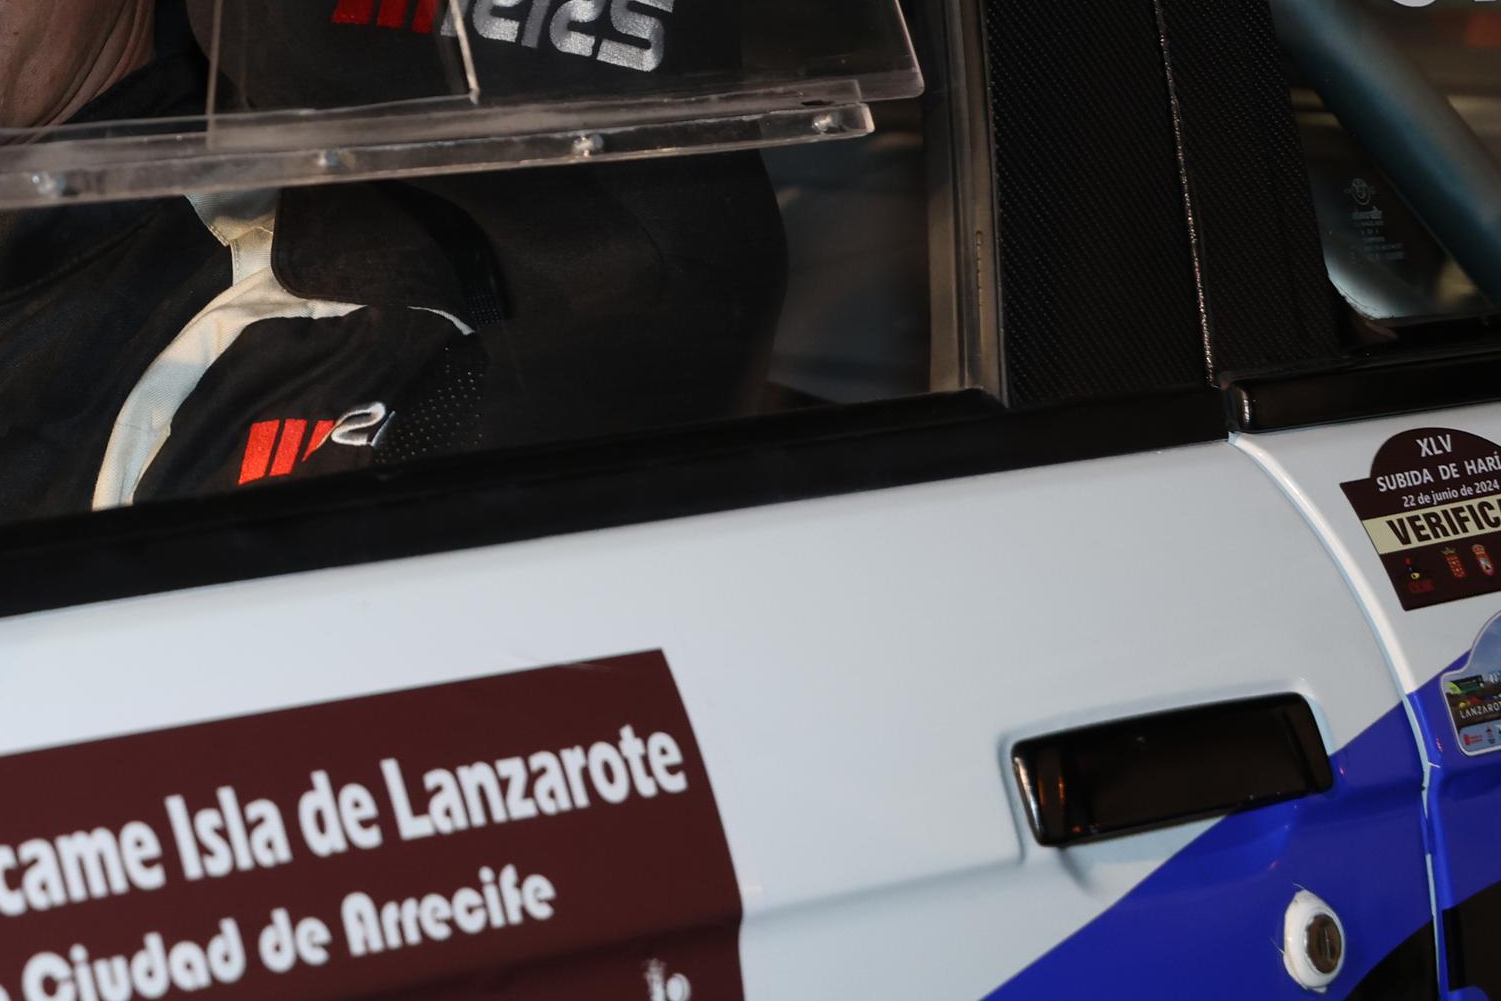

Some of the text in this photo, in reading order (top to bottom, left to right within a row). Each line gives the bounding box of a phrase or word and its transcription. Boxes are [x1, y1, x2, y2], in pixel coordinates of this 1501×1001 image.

[1416, 433, 1453, 457] XLV
[1376, 468, 1435, 492] SUBIDA
[1438, 463, 1461, 480] DE
[1402, 479, 1500, 508] 22 de junio de 2024
[1386, 499, 1501, 546] VERIFIC
[1460, 701, 1501, 719] LANZARO
[165, 787, 293, 881] Isla
[299, 770, 383, 858] de
[380, 724, 689, 841] Lanzarote
[21, 864, 557, 1001] Ciudad de Arrecife
